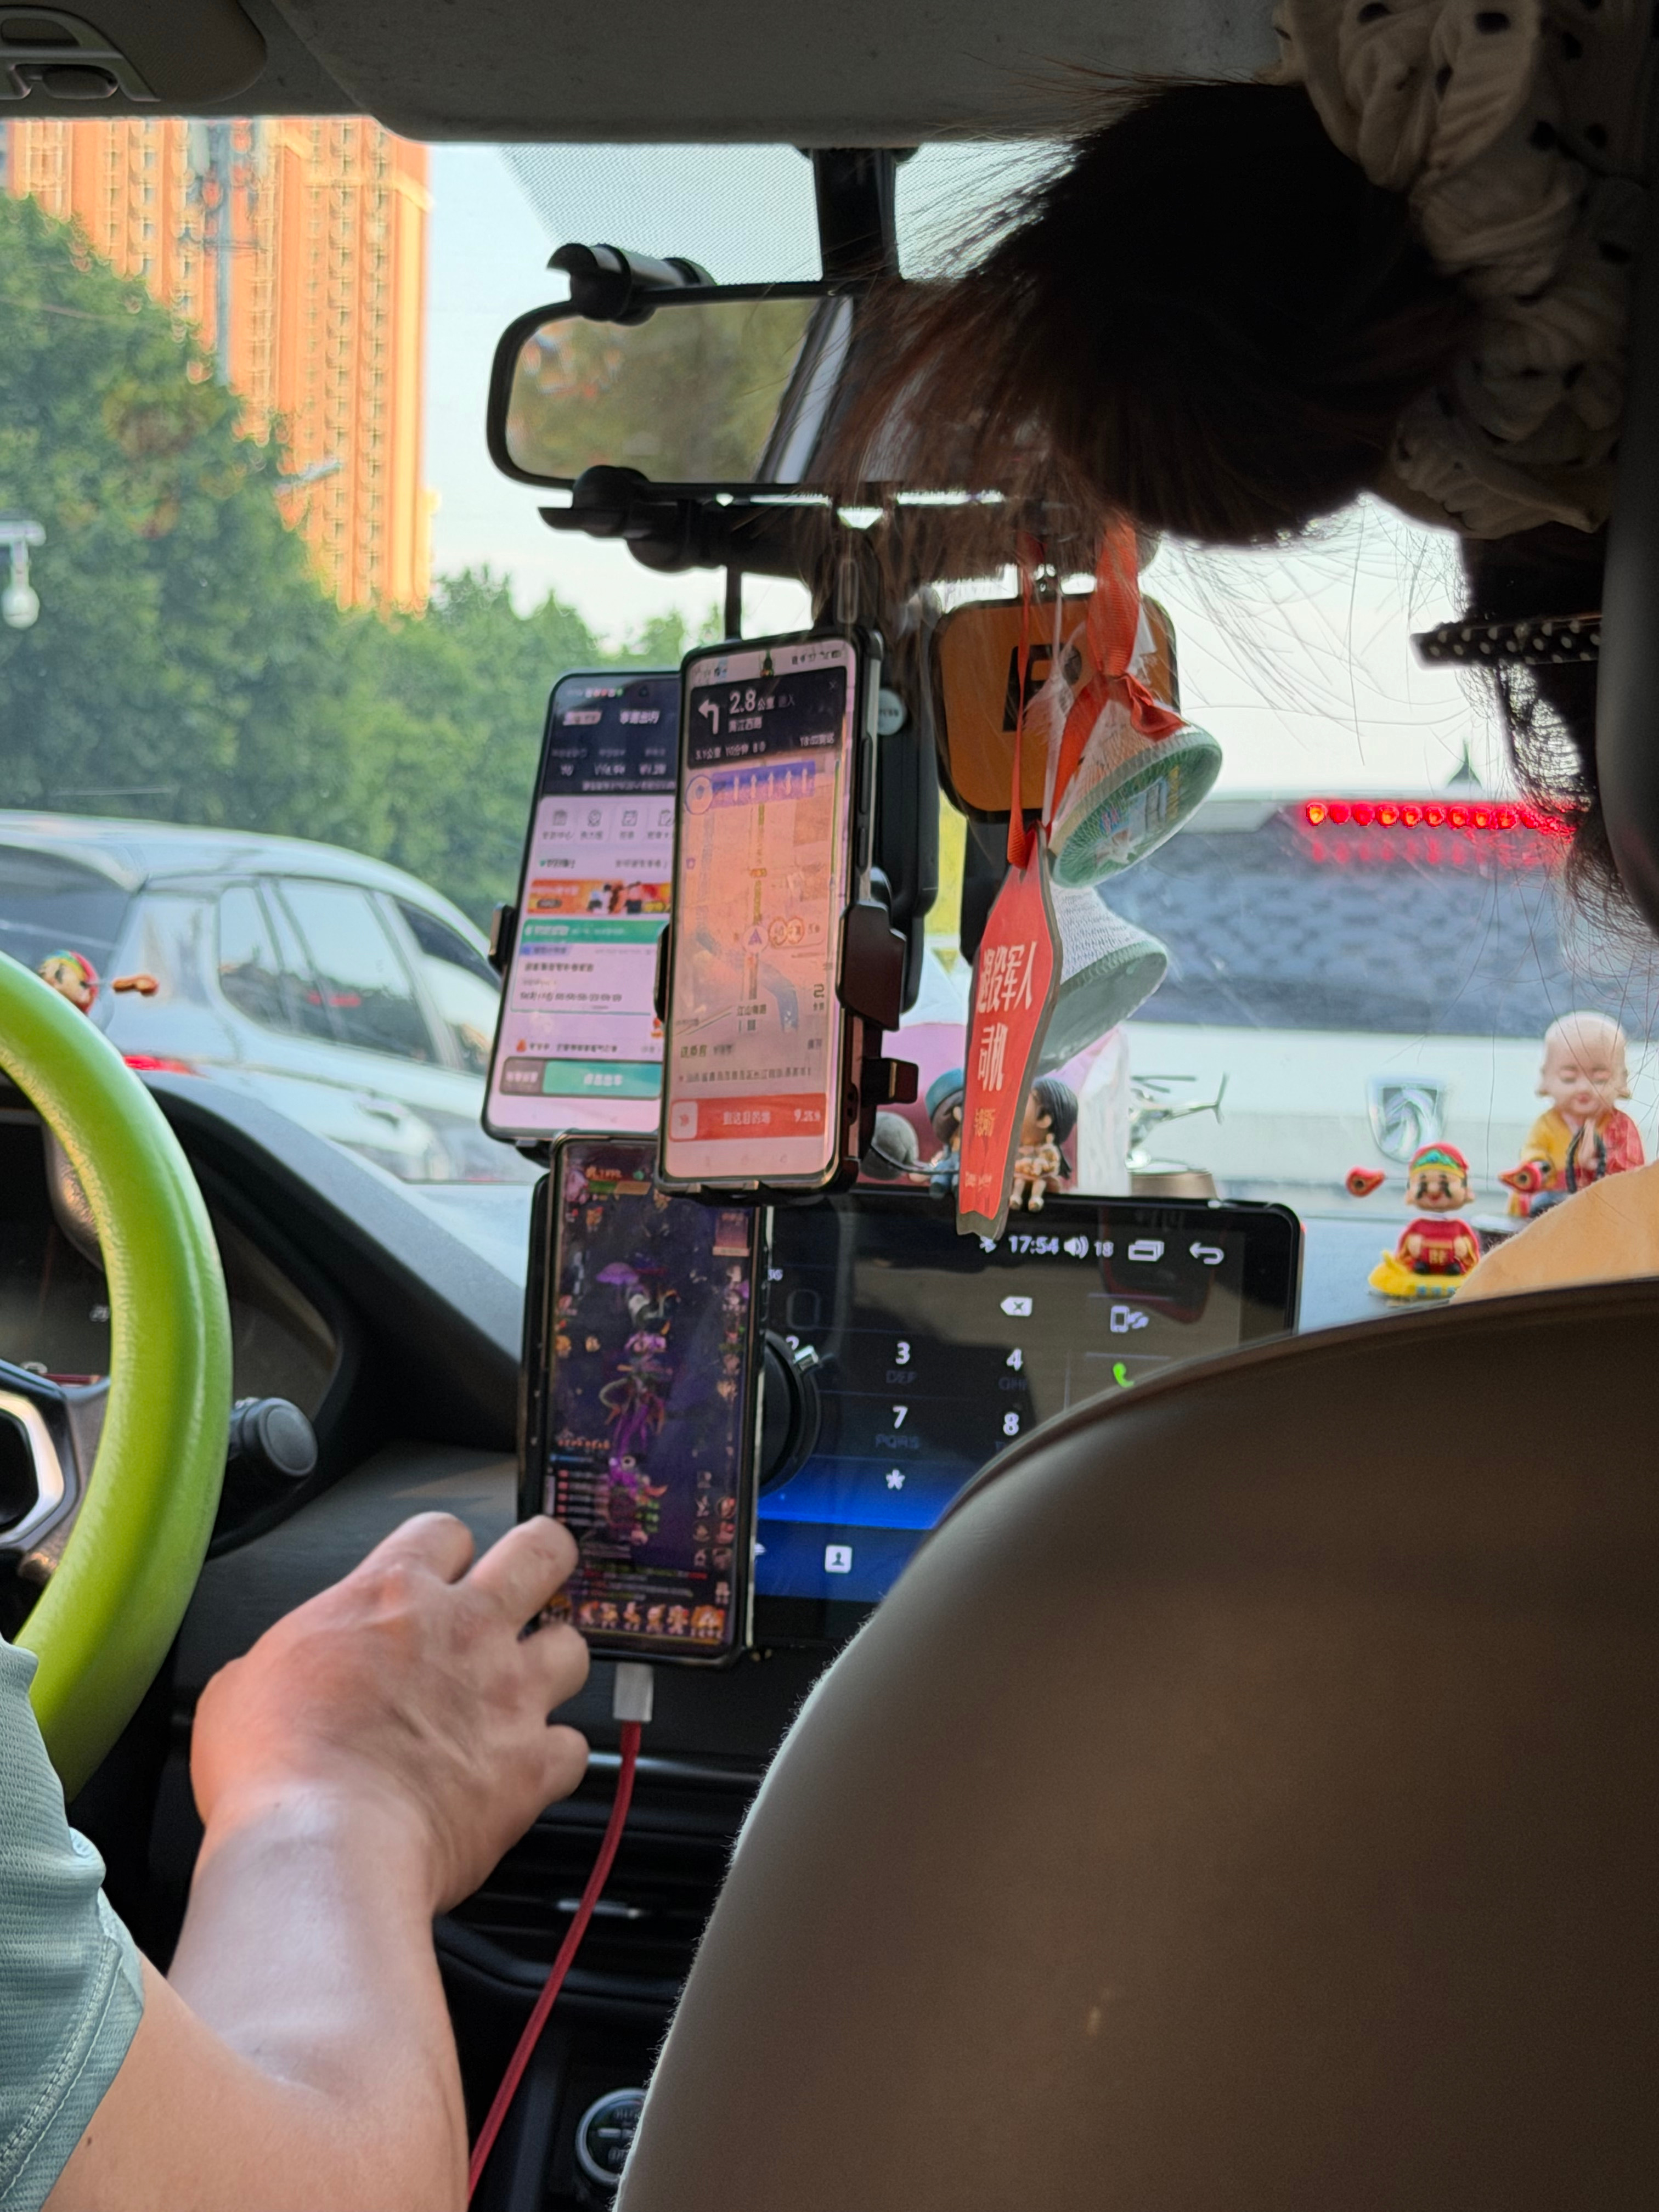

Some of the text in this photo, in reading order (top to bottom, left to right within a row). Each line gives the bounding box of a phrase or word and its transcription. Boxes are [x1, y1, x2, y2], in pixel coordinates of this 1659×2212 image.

[978, 1022, 1008, 1092] 司机
[1008, 1235, 1059, 1255] 17:54
[895, 1341, 911, 1364] 3
[1006, 1348, 1023, 1371] 4
[893, 1405, 909, 1429] 7
[1003, 1412, 1020, 1436] 8
